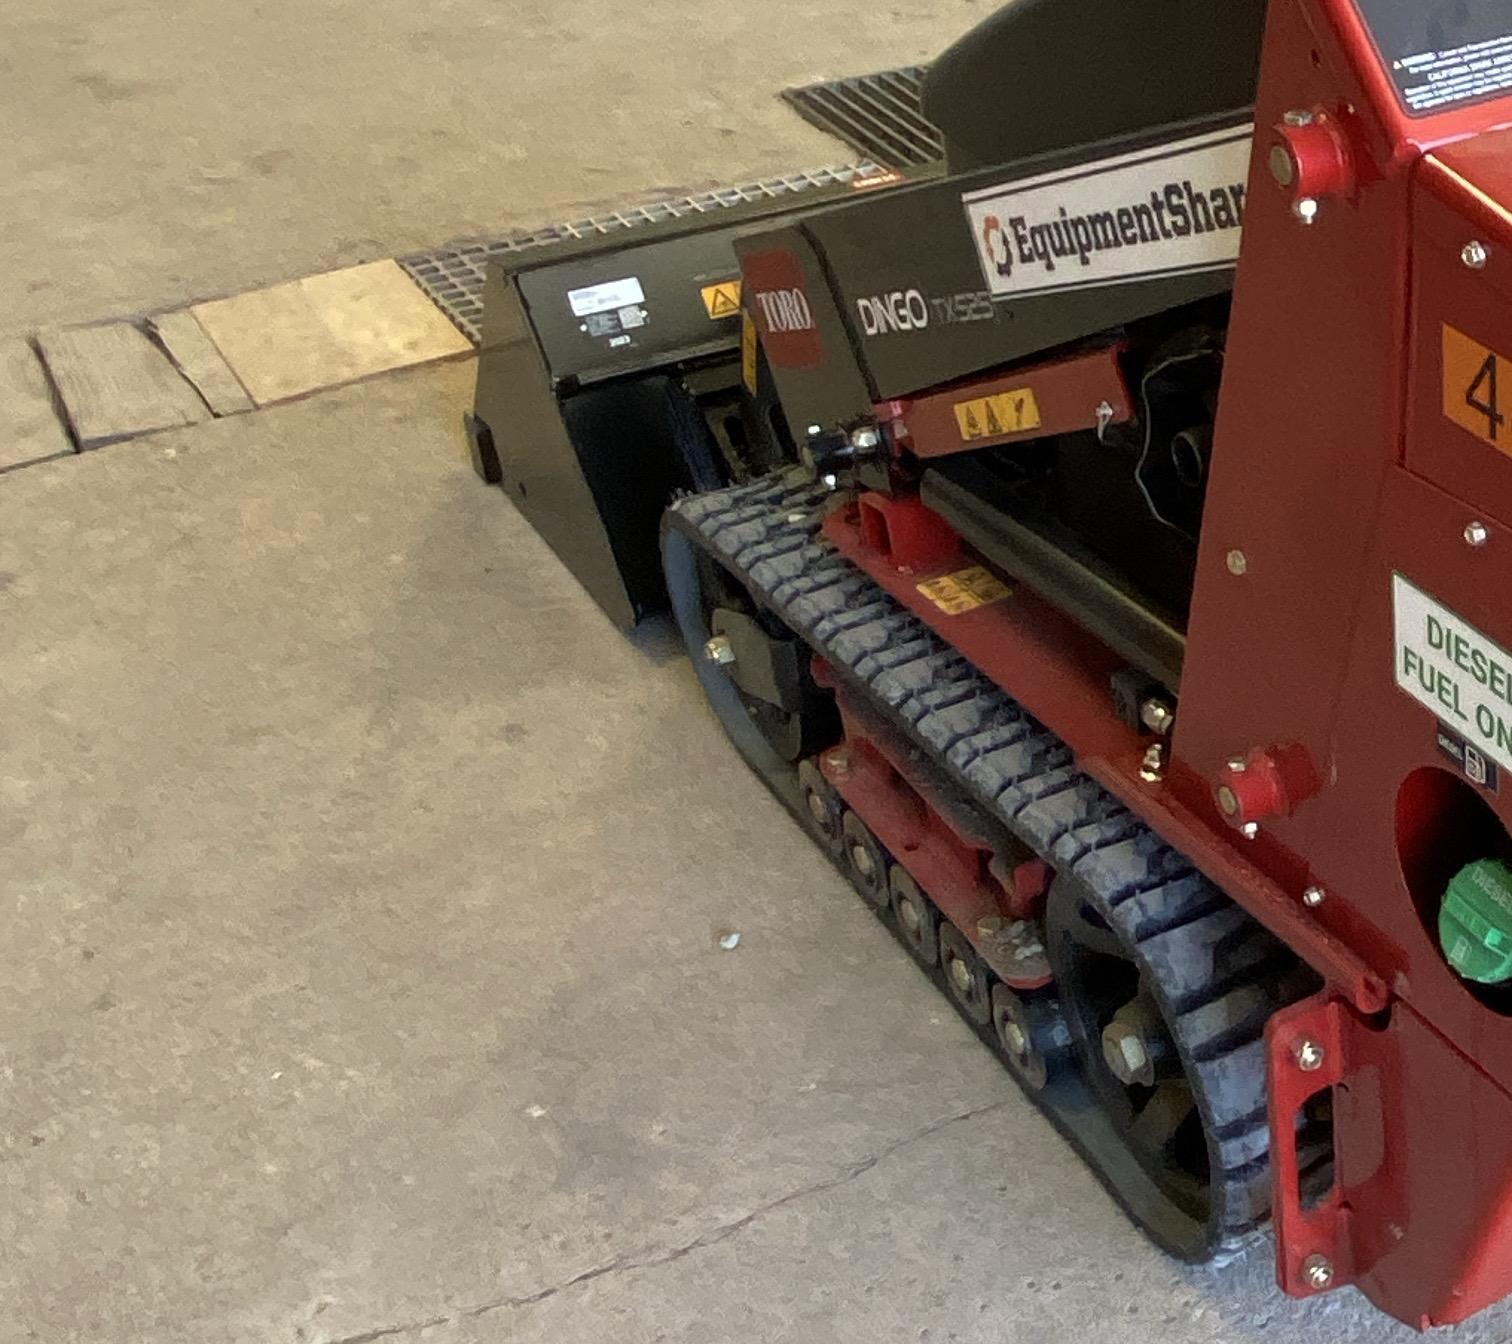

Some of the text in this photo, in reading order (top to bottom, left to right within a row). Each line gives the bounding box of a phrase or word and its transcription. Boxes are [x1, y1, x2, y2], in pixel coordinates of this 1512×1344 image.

[756, 288, 813, 333] TORO
[855, 289, 928, 336] DINGO
[1403, 645, 1469, 722] FUEL
